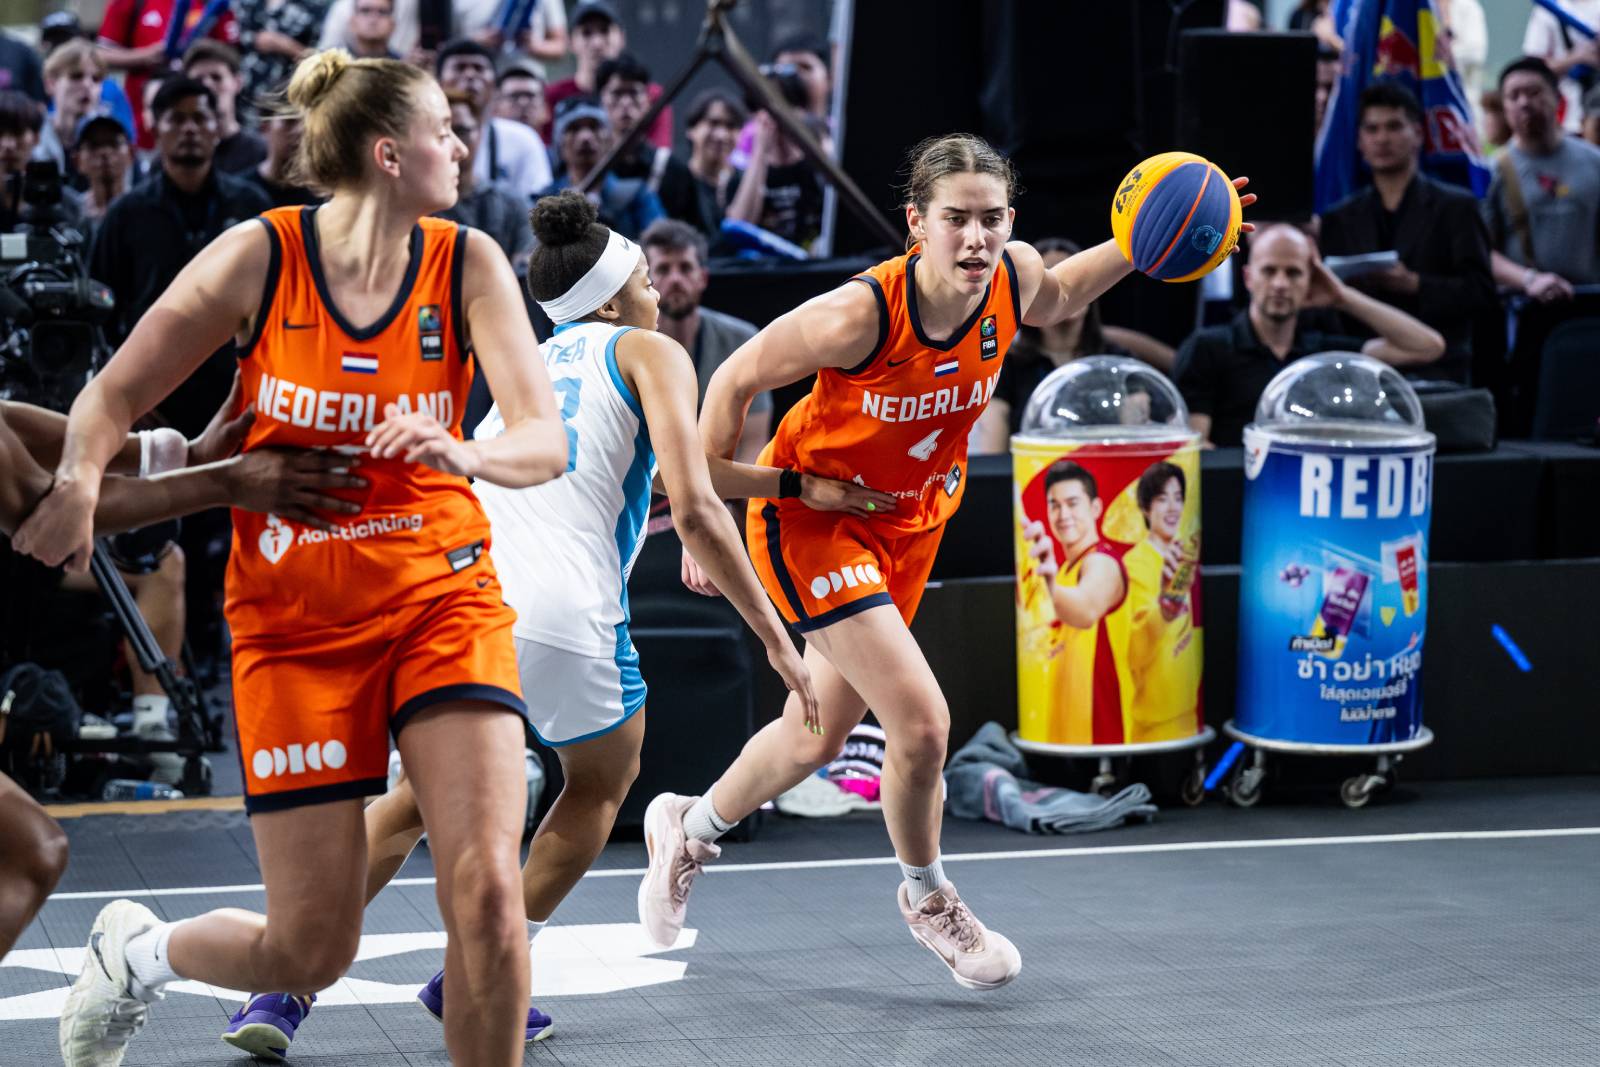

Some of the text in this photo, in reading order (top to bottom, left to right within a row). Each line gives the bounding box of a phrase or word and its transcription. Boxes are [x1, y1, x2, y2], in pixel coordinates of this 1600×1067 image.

[982, 339, 997, 350] FIBA
[907, 427, 945, 463] 4
[1300, 454, 1433, 520] REDB
[1332, 652, 1386, 681] อย่า
